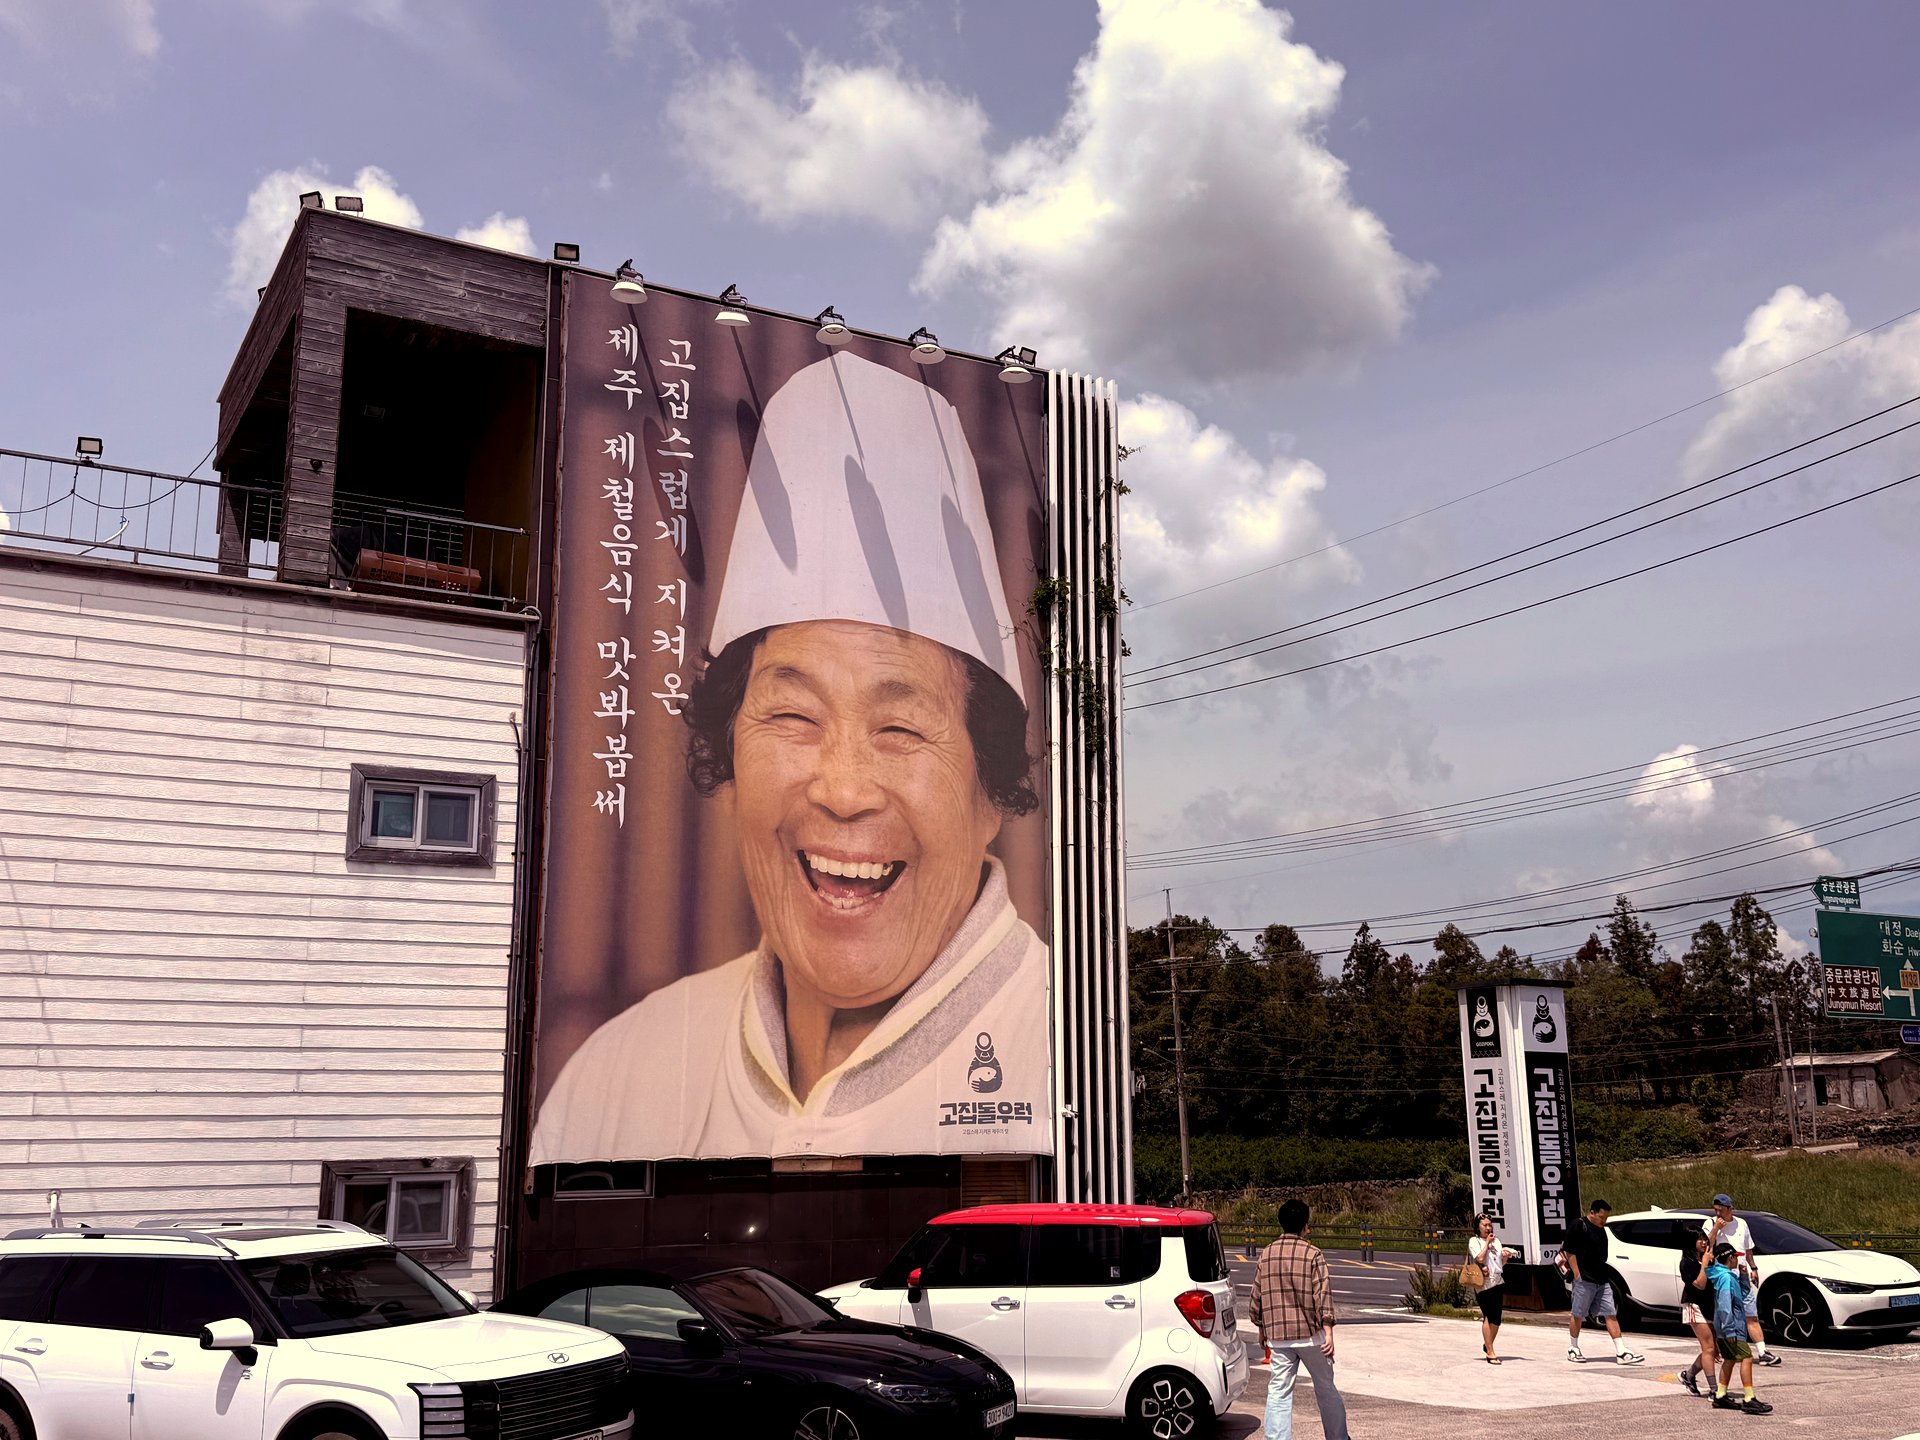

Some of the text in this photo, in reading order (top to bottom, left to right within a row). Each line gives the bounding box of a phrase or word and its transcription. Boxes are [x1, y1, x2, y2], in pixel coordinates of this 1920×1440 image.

[651, 338, 697, 716] 고집스럽게 지켜온
[591, 323, 643, 829] 제주 제철음식 맛봐봅써
[1880, 919, 1901, 937] 대정
[1882, 938, 1904, 956] 화순
[1825, 967, 1880, 985] 중문관광단지
[1902, 973, 1918, 986] 1132
[1828, 998, 1882, 1011] Jungmun Resort
[939, 1102, 1032, 1126] 고집돌우럭
[1473, 1068, 1506, 1229] 고집돌우럭
[1534, 1068, 1567, 1230] 고집돌우럭
